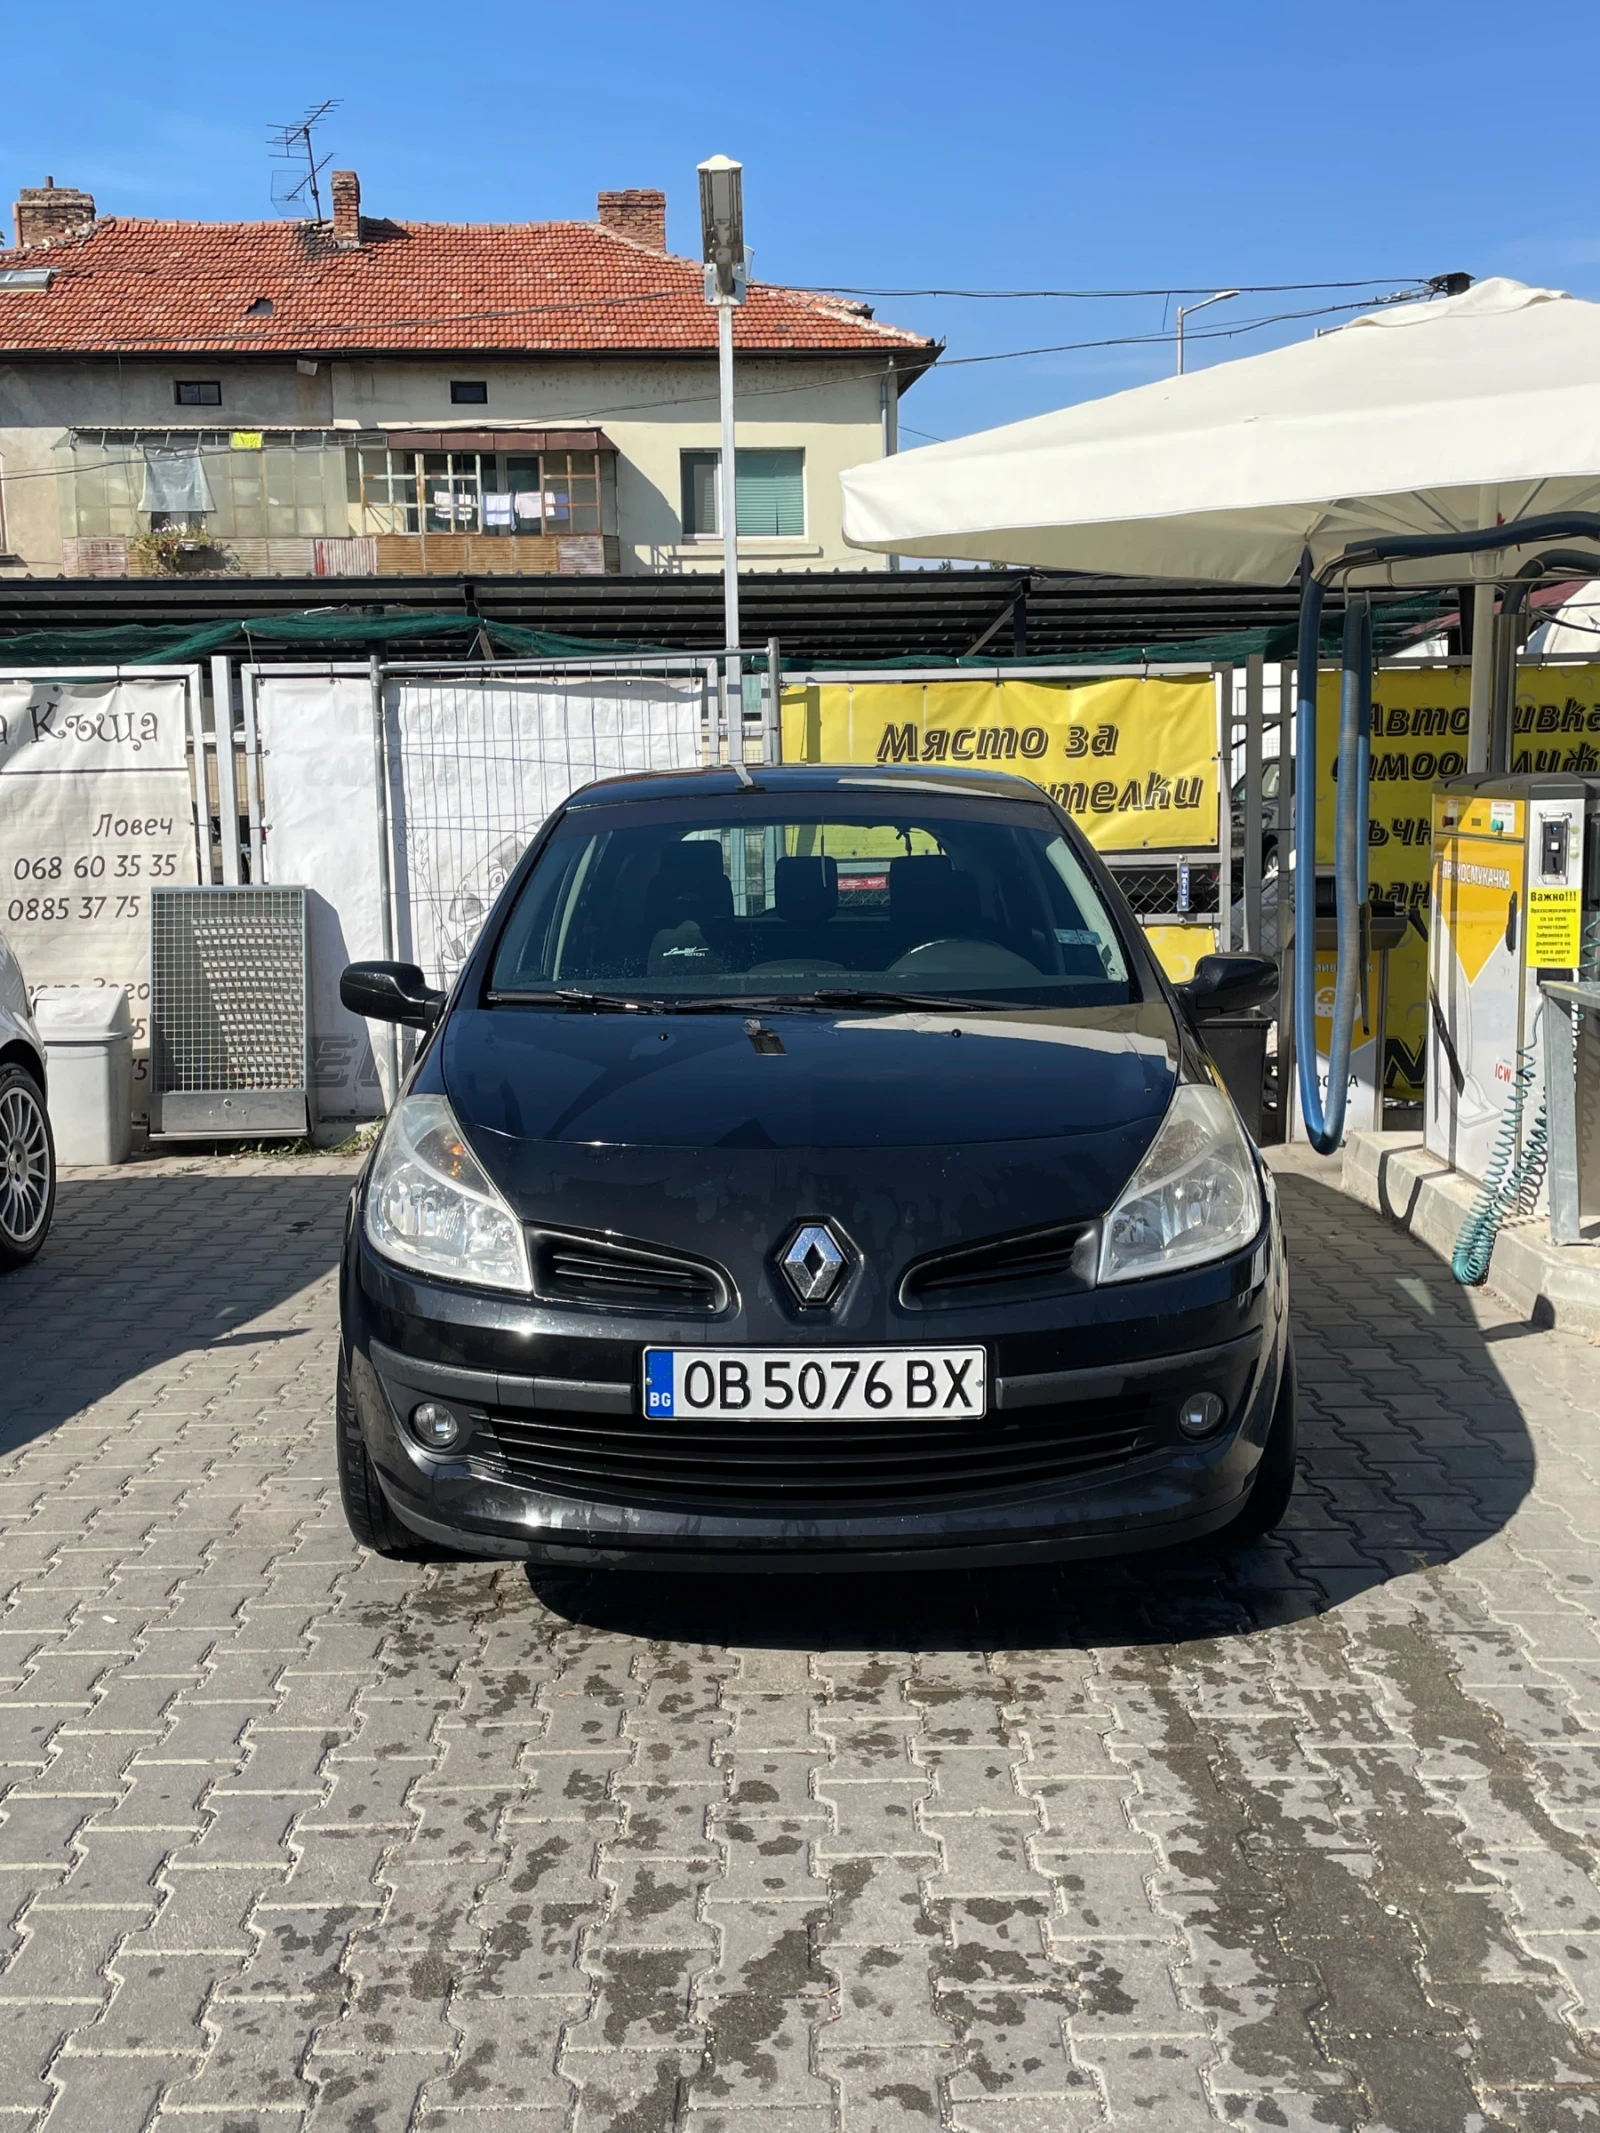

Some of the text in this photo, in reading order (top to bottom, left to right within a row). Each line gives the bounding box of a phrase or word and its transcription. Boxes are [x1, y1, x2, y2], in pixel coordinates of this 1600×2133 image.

[27, 701, 159, 751] Къща
[876, 721, 1119, 763] Място за
[92, 813, 173, 838] Ловеч
[13, 854, 177, 880] 068 60 35 35
[8, 896, 141, 921] 0885 37 75
[1530, 891, 1577, 902] Важно!!!
[1495, 1063, 1511, 1083] ICW
[649, 1392, 672, 1408] BG
